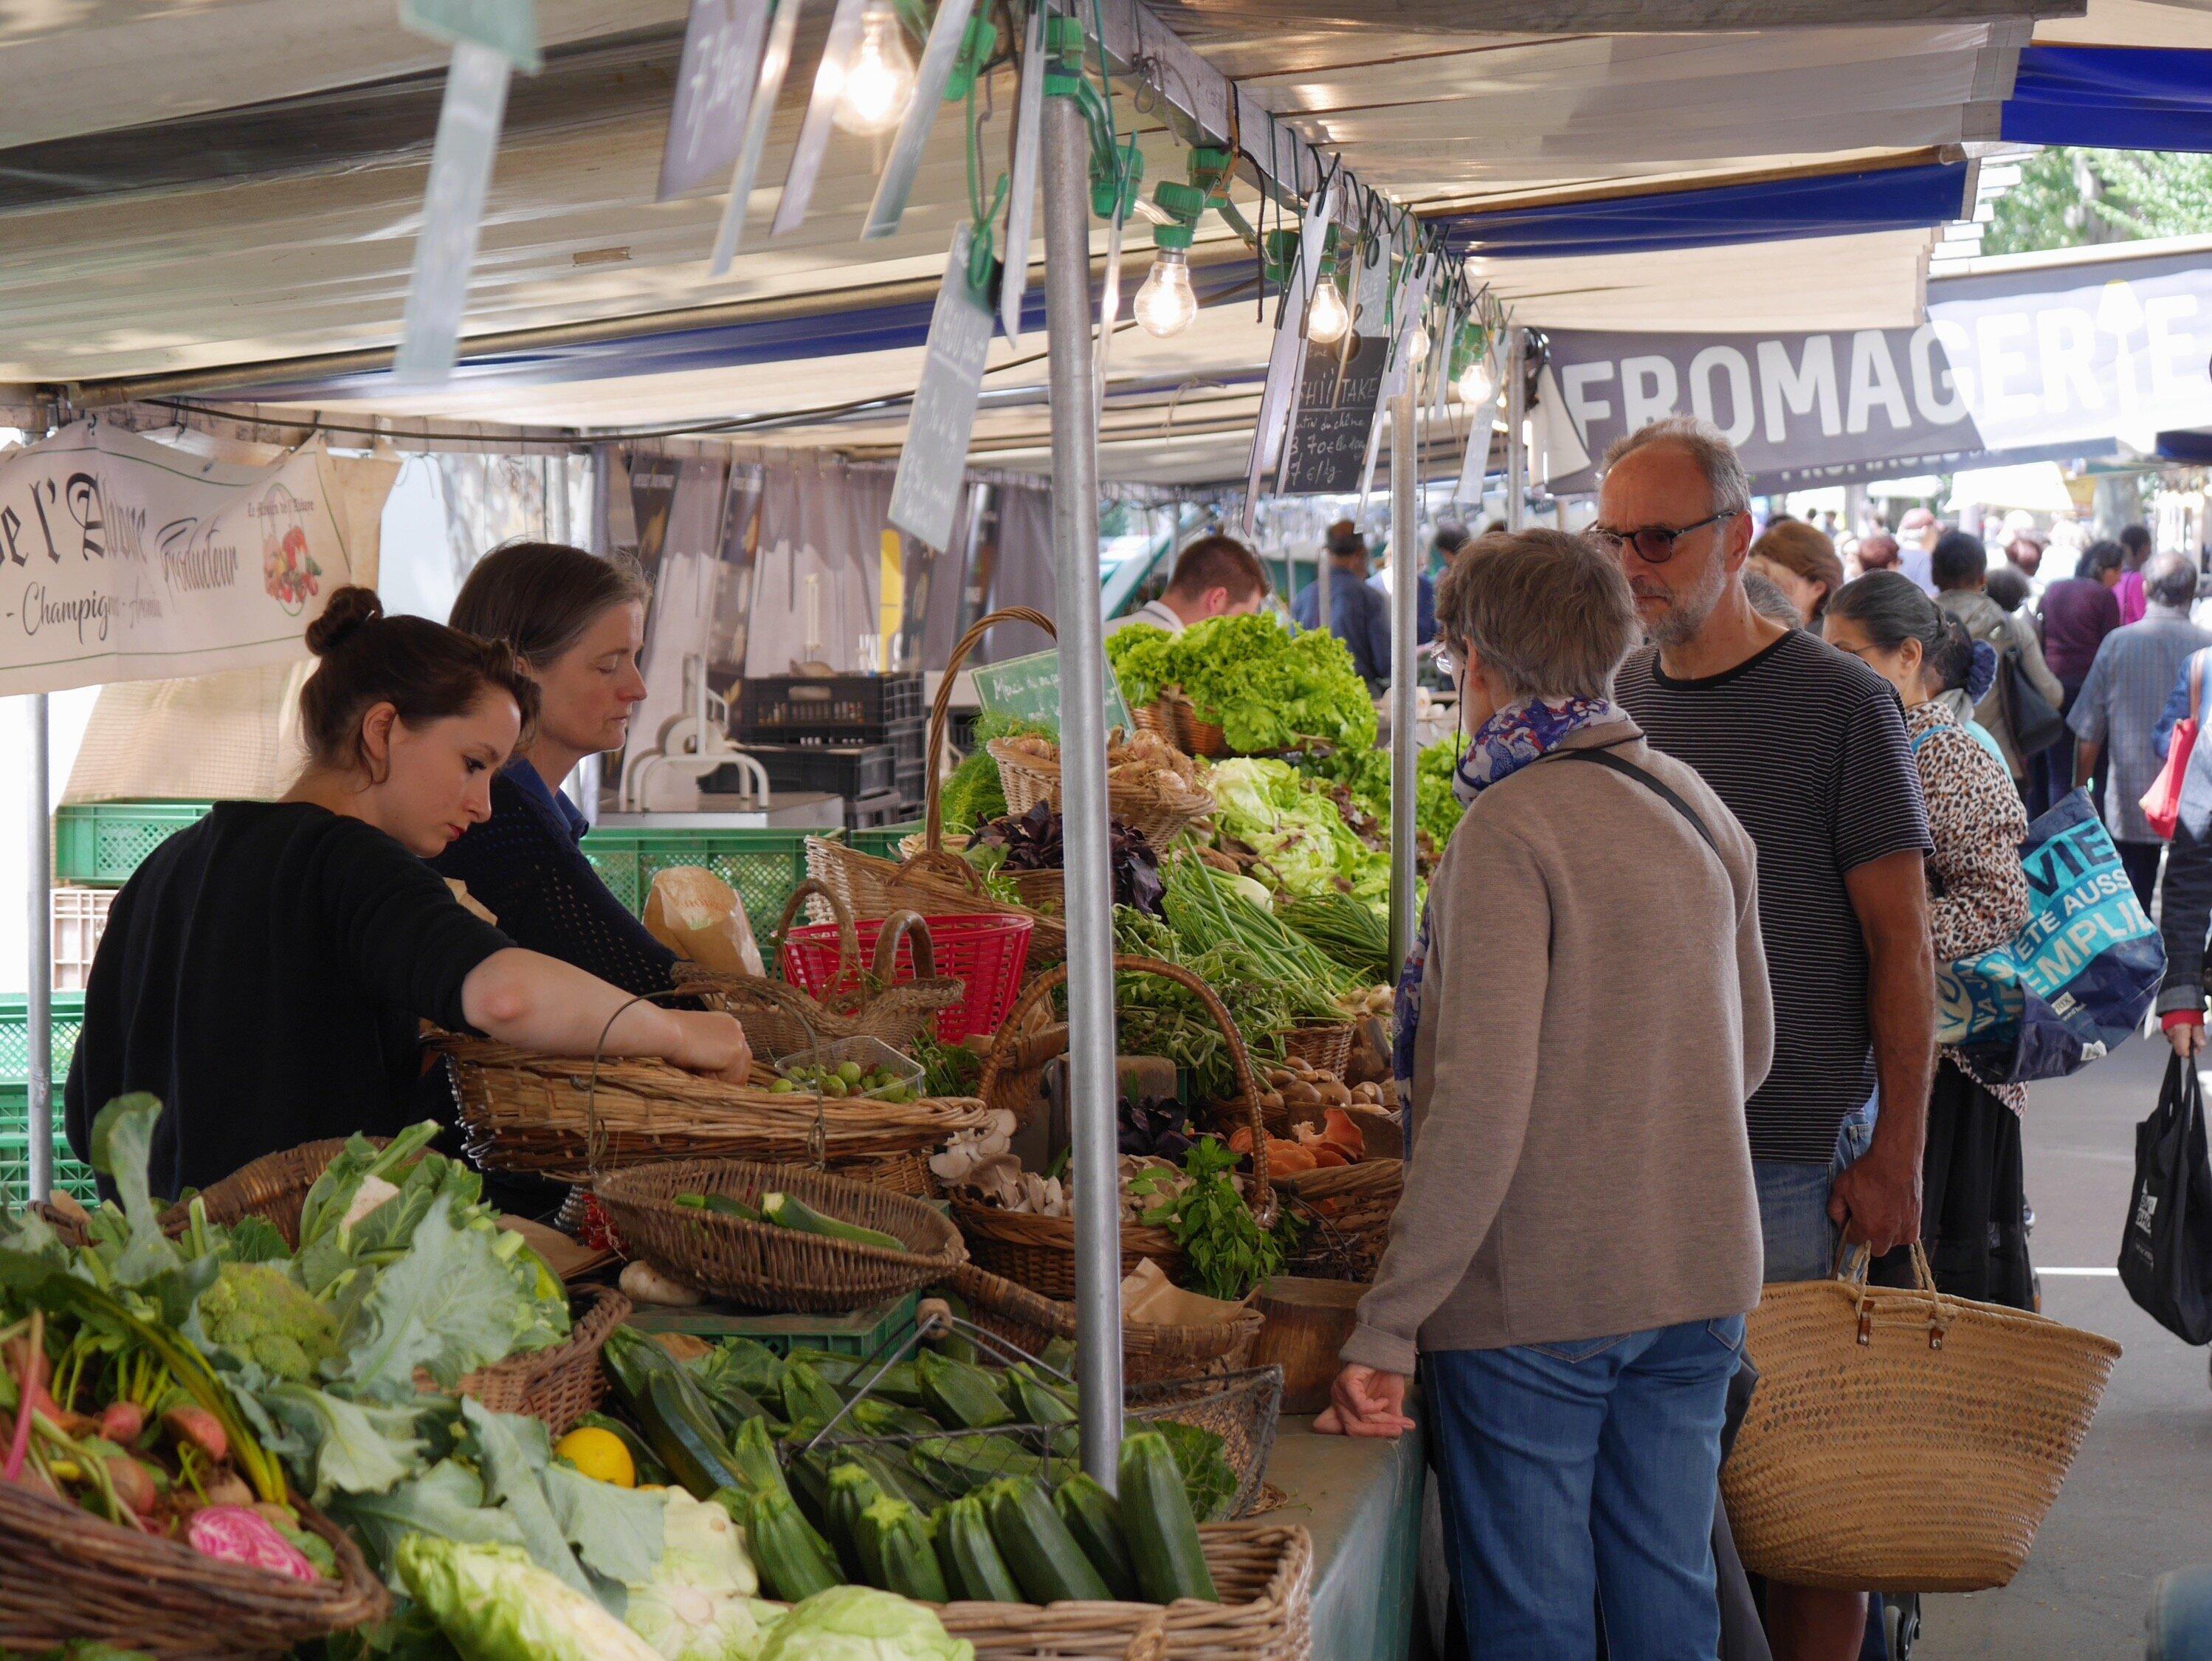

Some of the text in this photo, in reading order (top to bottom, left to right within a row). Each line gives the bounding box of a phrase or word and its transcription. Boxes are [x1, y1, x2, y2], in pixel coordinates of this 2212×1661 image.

[1561, 281, 2210, 452] FROMAGERIE
[0, 505, 29, 567] e
[2023, 823, 2116, 898] VIE
[2063, 868, 2132, 917] AUSS
[2017, 898, 2156, 995] EMPLIE
